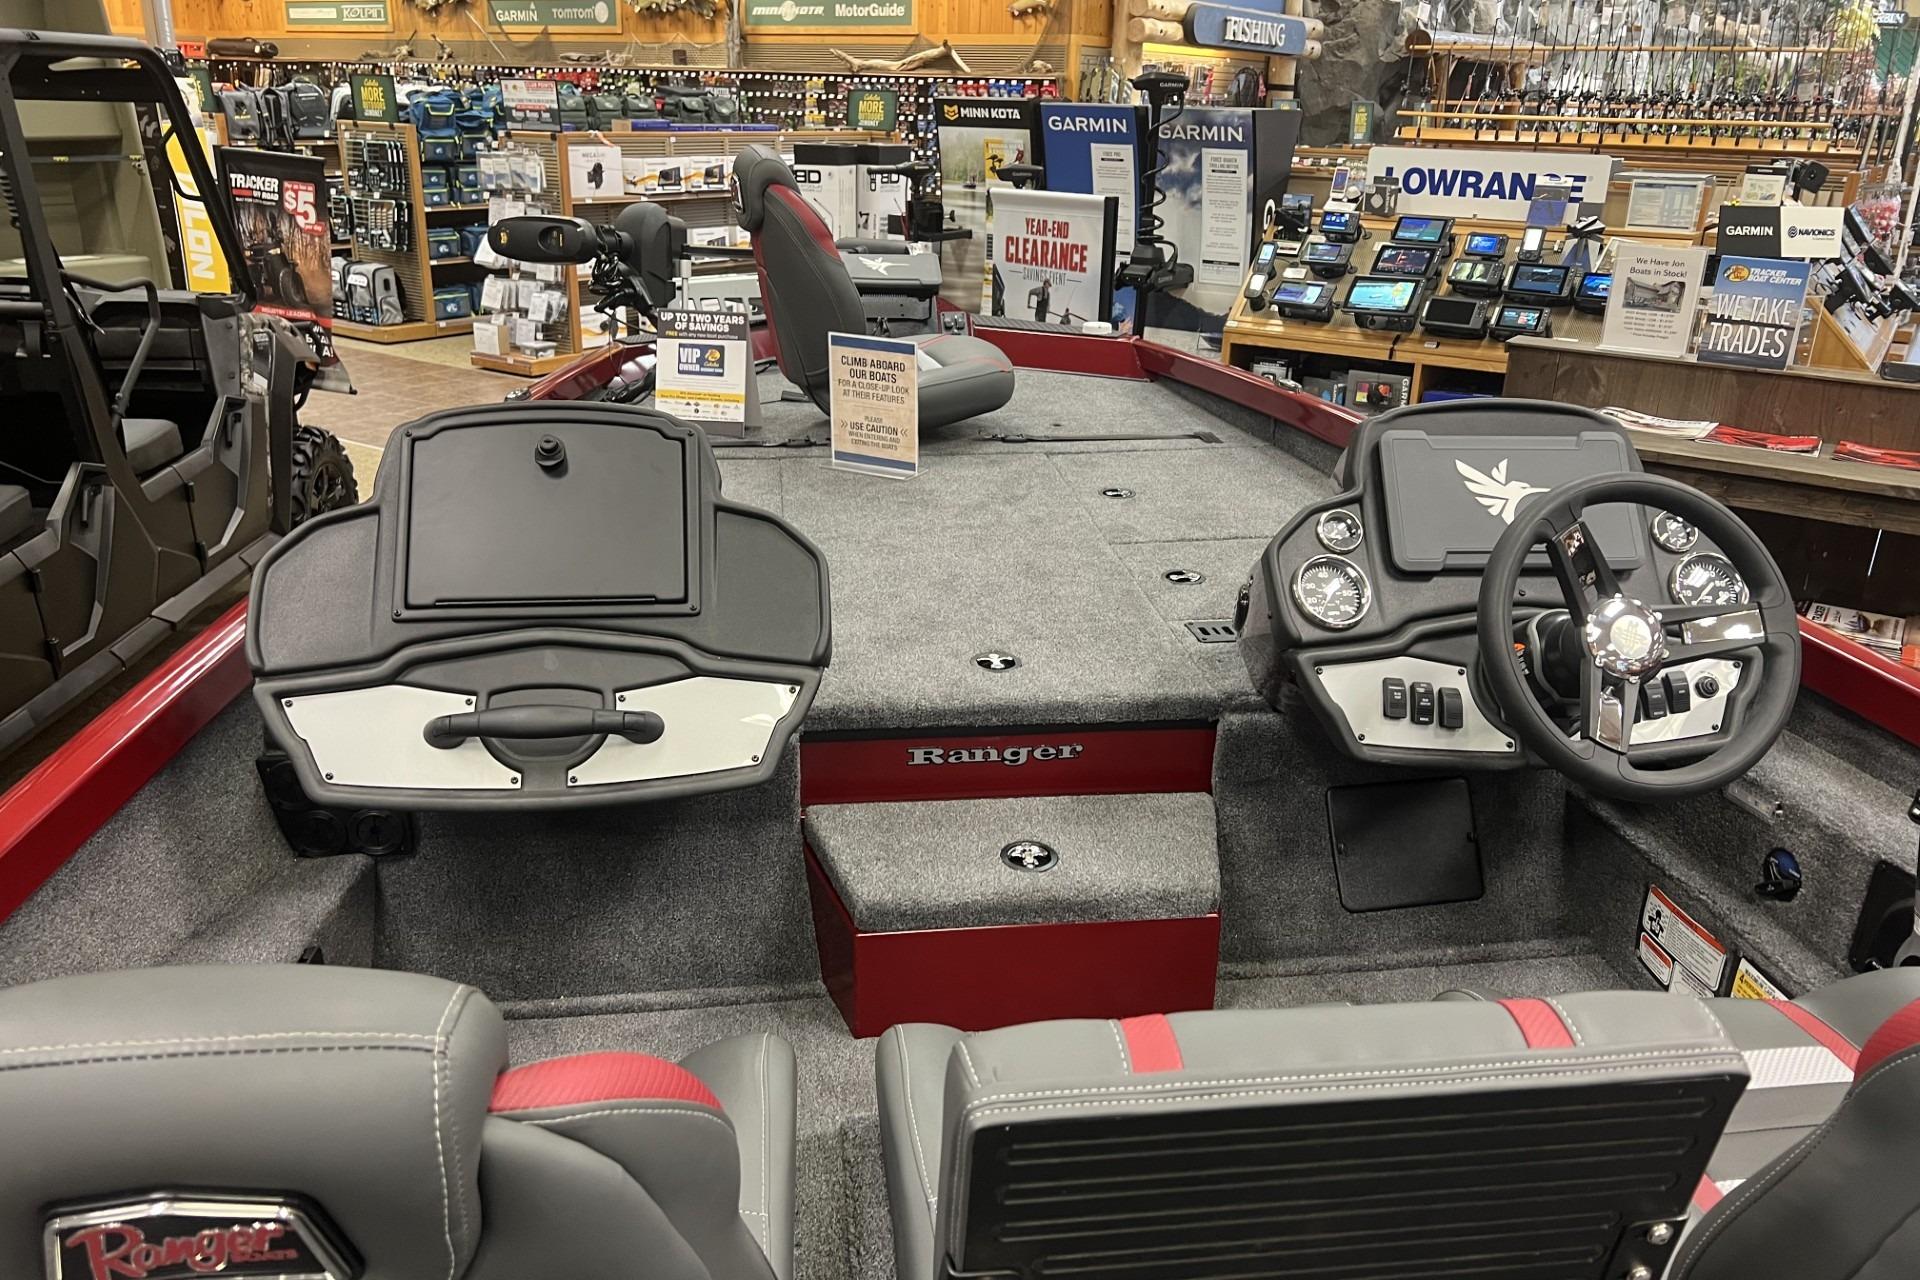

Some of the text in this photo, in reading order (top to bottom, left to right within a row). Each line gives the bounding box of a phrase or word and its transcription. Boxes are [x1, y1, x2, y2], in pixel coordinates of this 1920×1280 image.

[495, 9, 538, 22] GARMIN
[835, 4, 905, 17] MotorGuide
[1224, 16, 1286, 47] FISHING
[1159, 81, 1184, 89] GARMIN
[360, 86, 385, 102] MORE
[858, 100, 885, 113] MORE
[960, 107, 1021, 120] MINN KOTA
[1048, 115, 1128, 133] GARMIN
[1158, 124, 1243, 143] GARMIN
[229, 172, 280, 193] TRACKER
[1386, 166, 1588, 204] OWRANE
[284, 190, 317, 228] $5
[1025, 217, 1070, 239] YEAR-END
[1725, 225, 1774, 236] GARMIN
[1798, 228, 1836, 237] NAVIONICS
[1005, 235, 1088, 273] CLEARANCE
[1636, 257, 1648, 265] We
[1650, 259, 1670, 267] Have
[1629, 266, 1688, 278] Boats in Stock!
[1750, 267, 1788, 277] TRACKER
[1748, 275, 1803, 286] BOAT CENTER
[660, 311, 744, 325] UP TO TWO YEARS
[1715, 293, 1796, 327] WE TAKE
[674, 321, 730, 333] OF SAVINGS
[1707, 321, 1788, 358] TRADES
[679, 347, 701, 364] VIP
[841, 355, 906, 373] CLIMB ABOARD
[849, 368, 898, 384] OUR BOATS
[838, 378, 910, 395] FOR A CLOSE-UP LOOK
[1399, 378, 1410, 406] GARM
[842, 388, 906, 405] AT THEIR FEATURES
[849, 421, 899, 436] USE CAUTION
[907, 743, 1085, 766] Ranger
[65, 1223, 285, 1280] Ranger
[232, 1249, 298, 1262] BOATS
